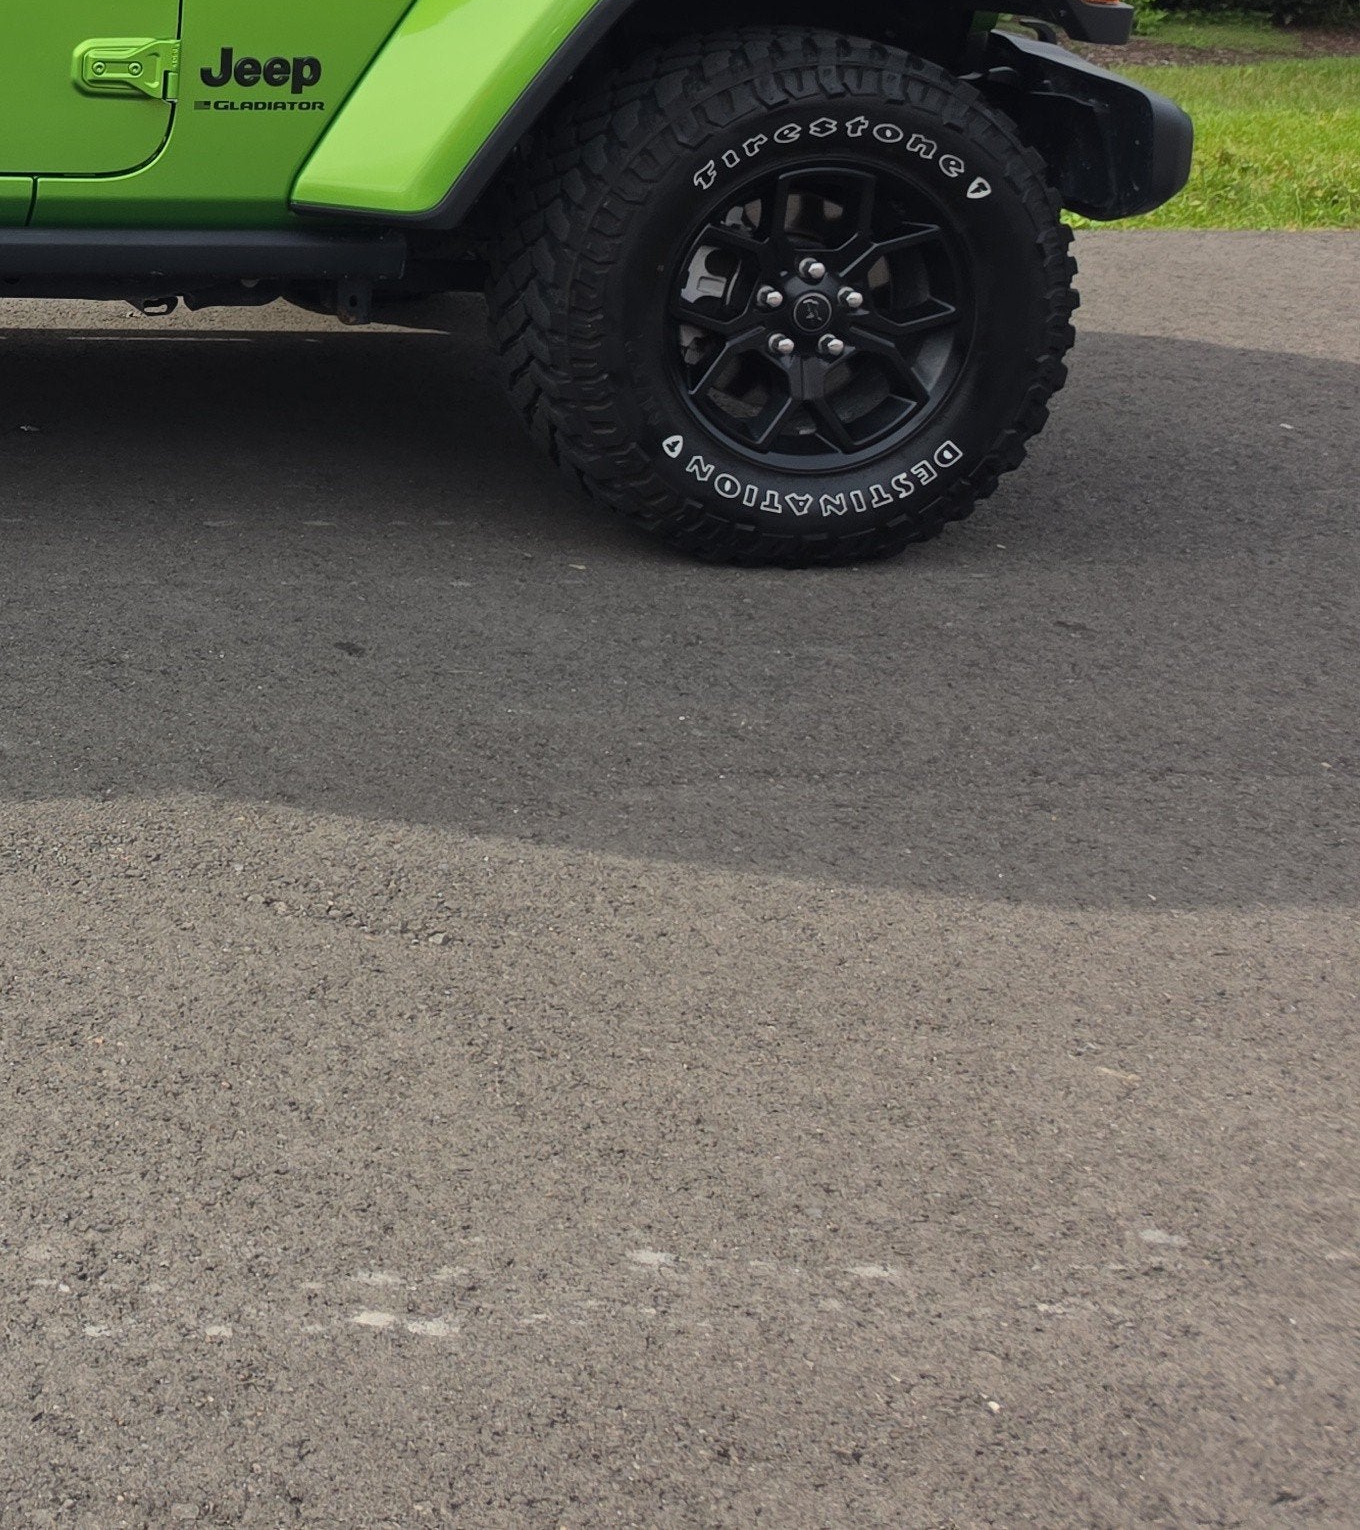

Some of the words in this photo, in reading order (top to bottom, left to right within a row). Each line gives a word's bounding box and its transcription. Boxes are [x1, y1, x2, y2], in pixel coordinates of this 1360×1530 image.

[200, 47, 322, 94] Jeep
[213, 100, 325, 111] GLADIATOR
[685, 440, 963, 517] DESTINATION
